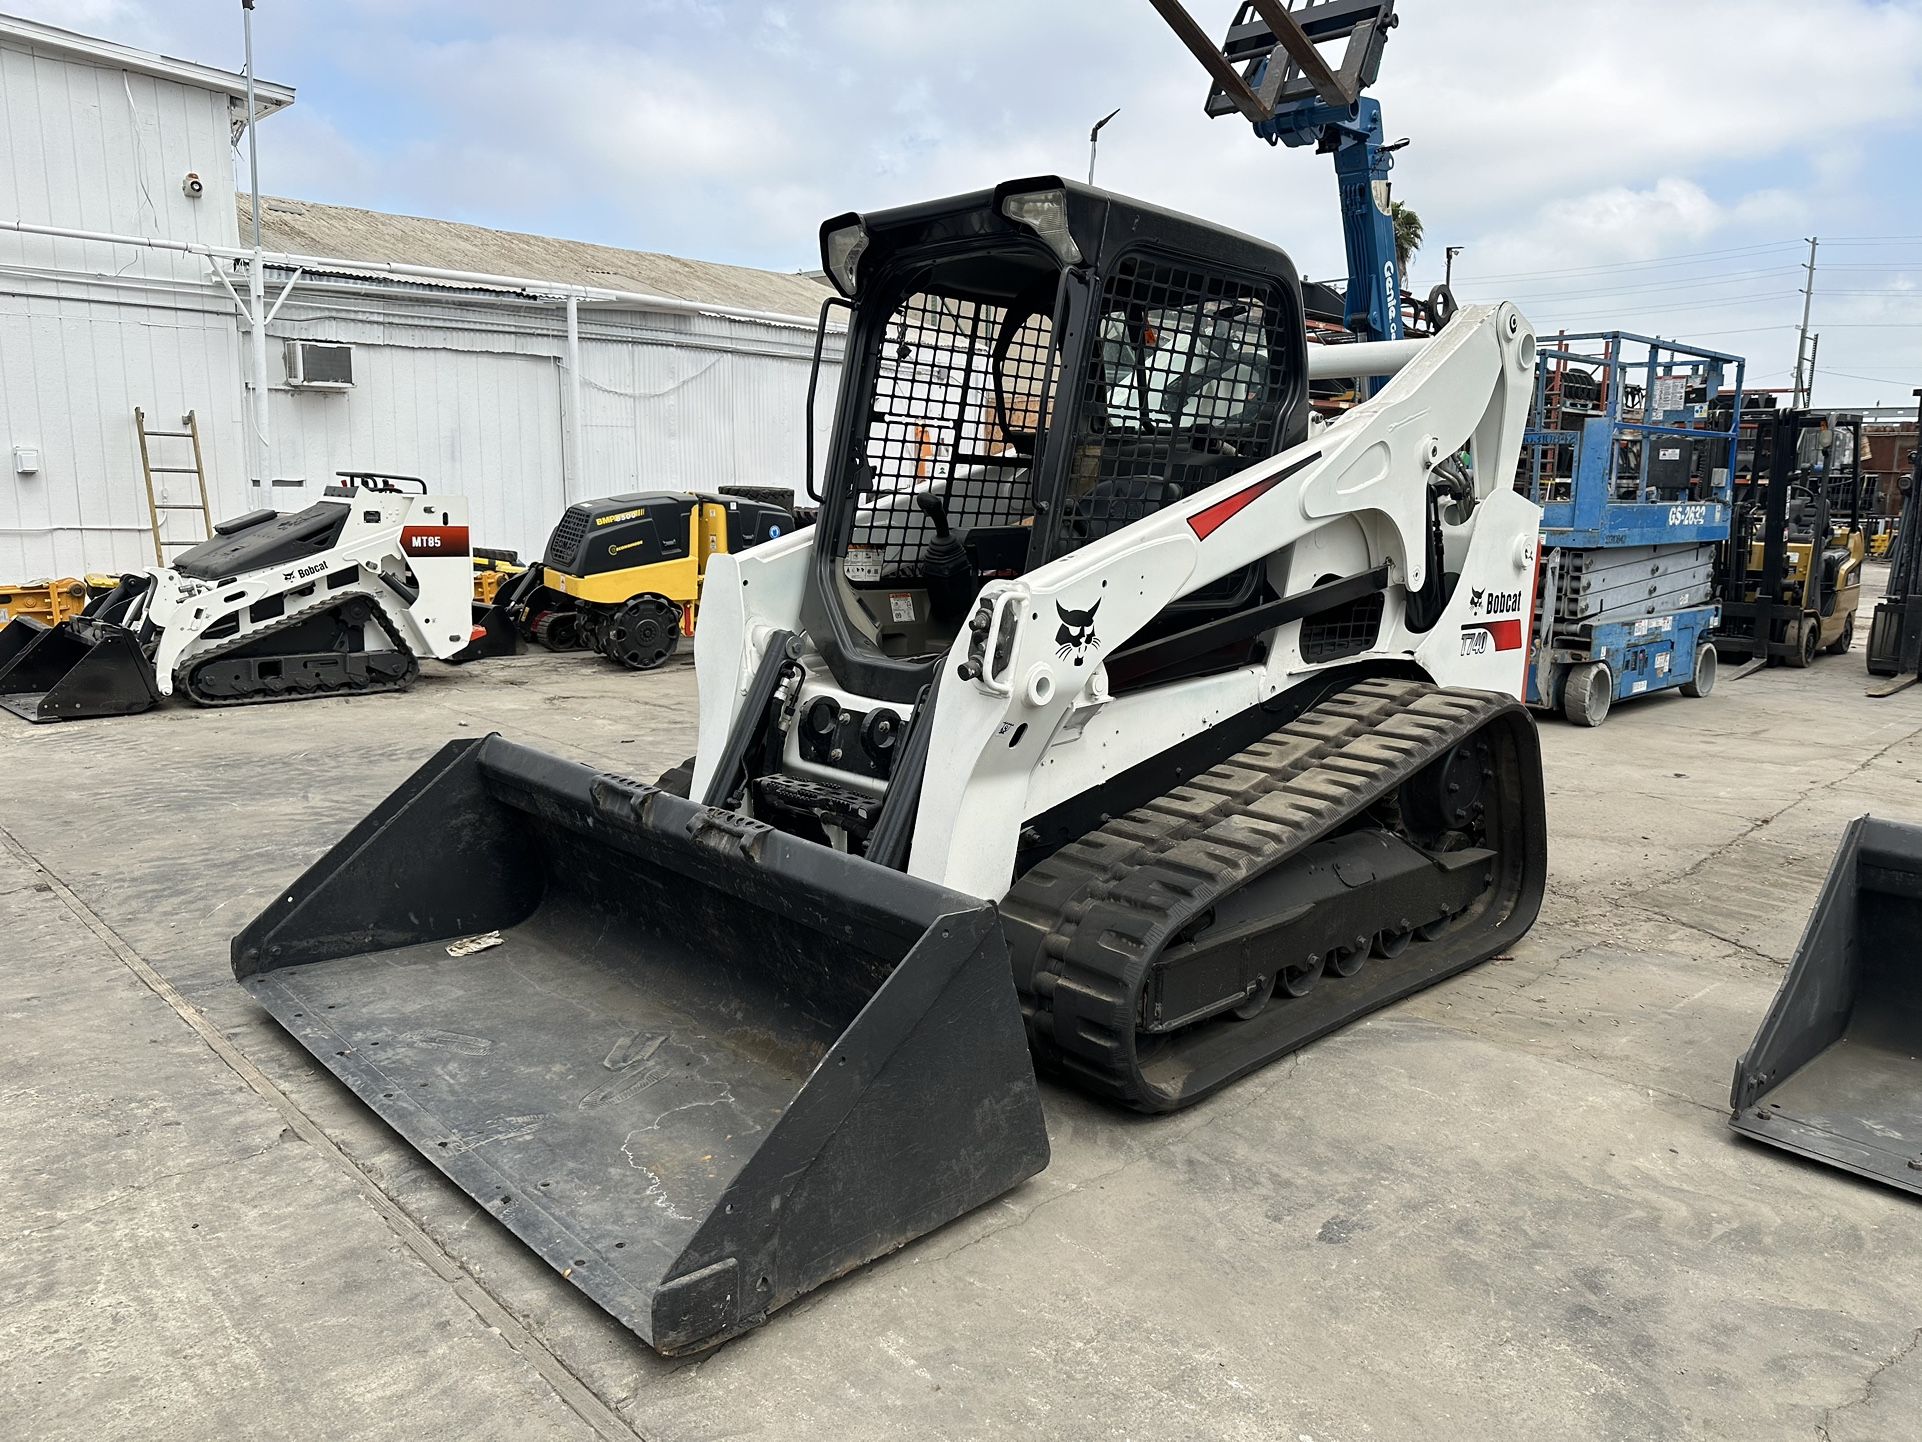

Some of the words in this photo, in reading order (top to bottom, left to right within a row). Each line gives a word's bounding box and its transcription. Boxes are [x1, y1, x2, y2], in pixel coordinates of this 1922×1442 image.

[1668, 505, 1706, 526] GS-2632
[411, 536, 441, 548] MT85
[297, 560, 329, 579] Bobcat
[1486, 590, 1522, 615] Bobcat
[1460, 631, 1488, 657] T740
